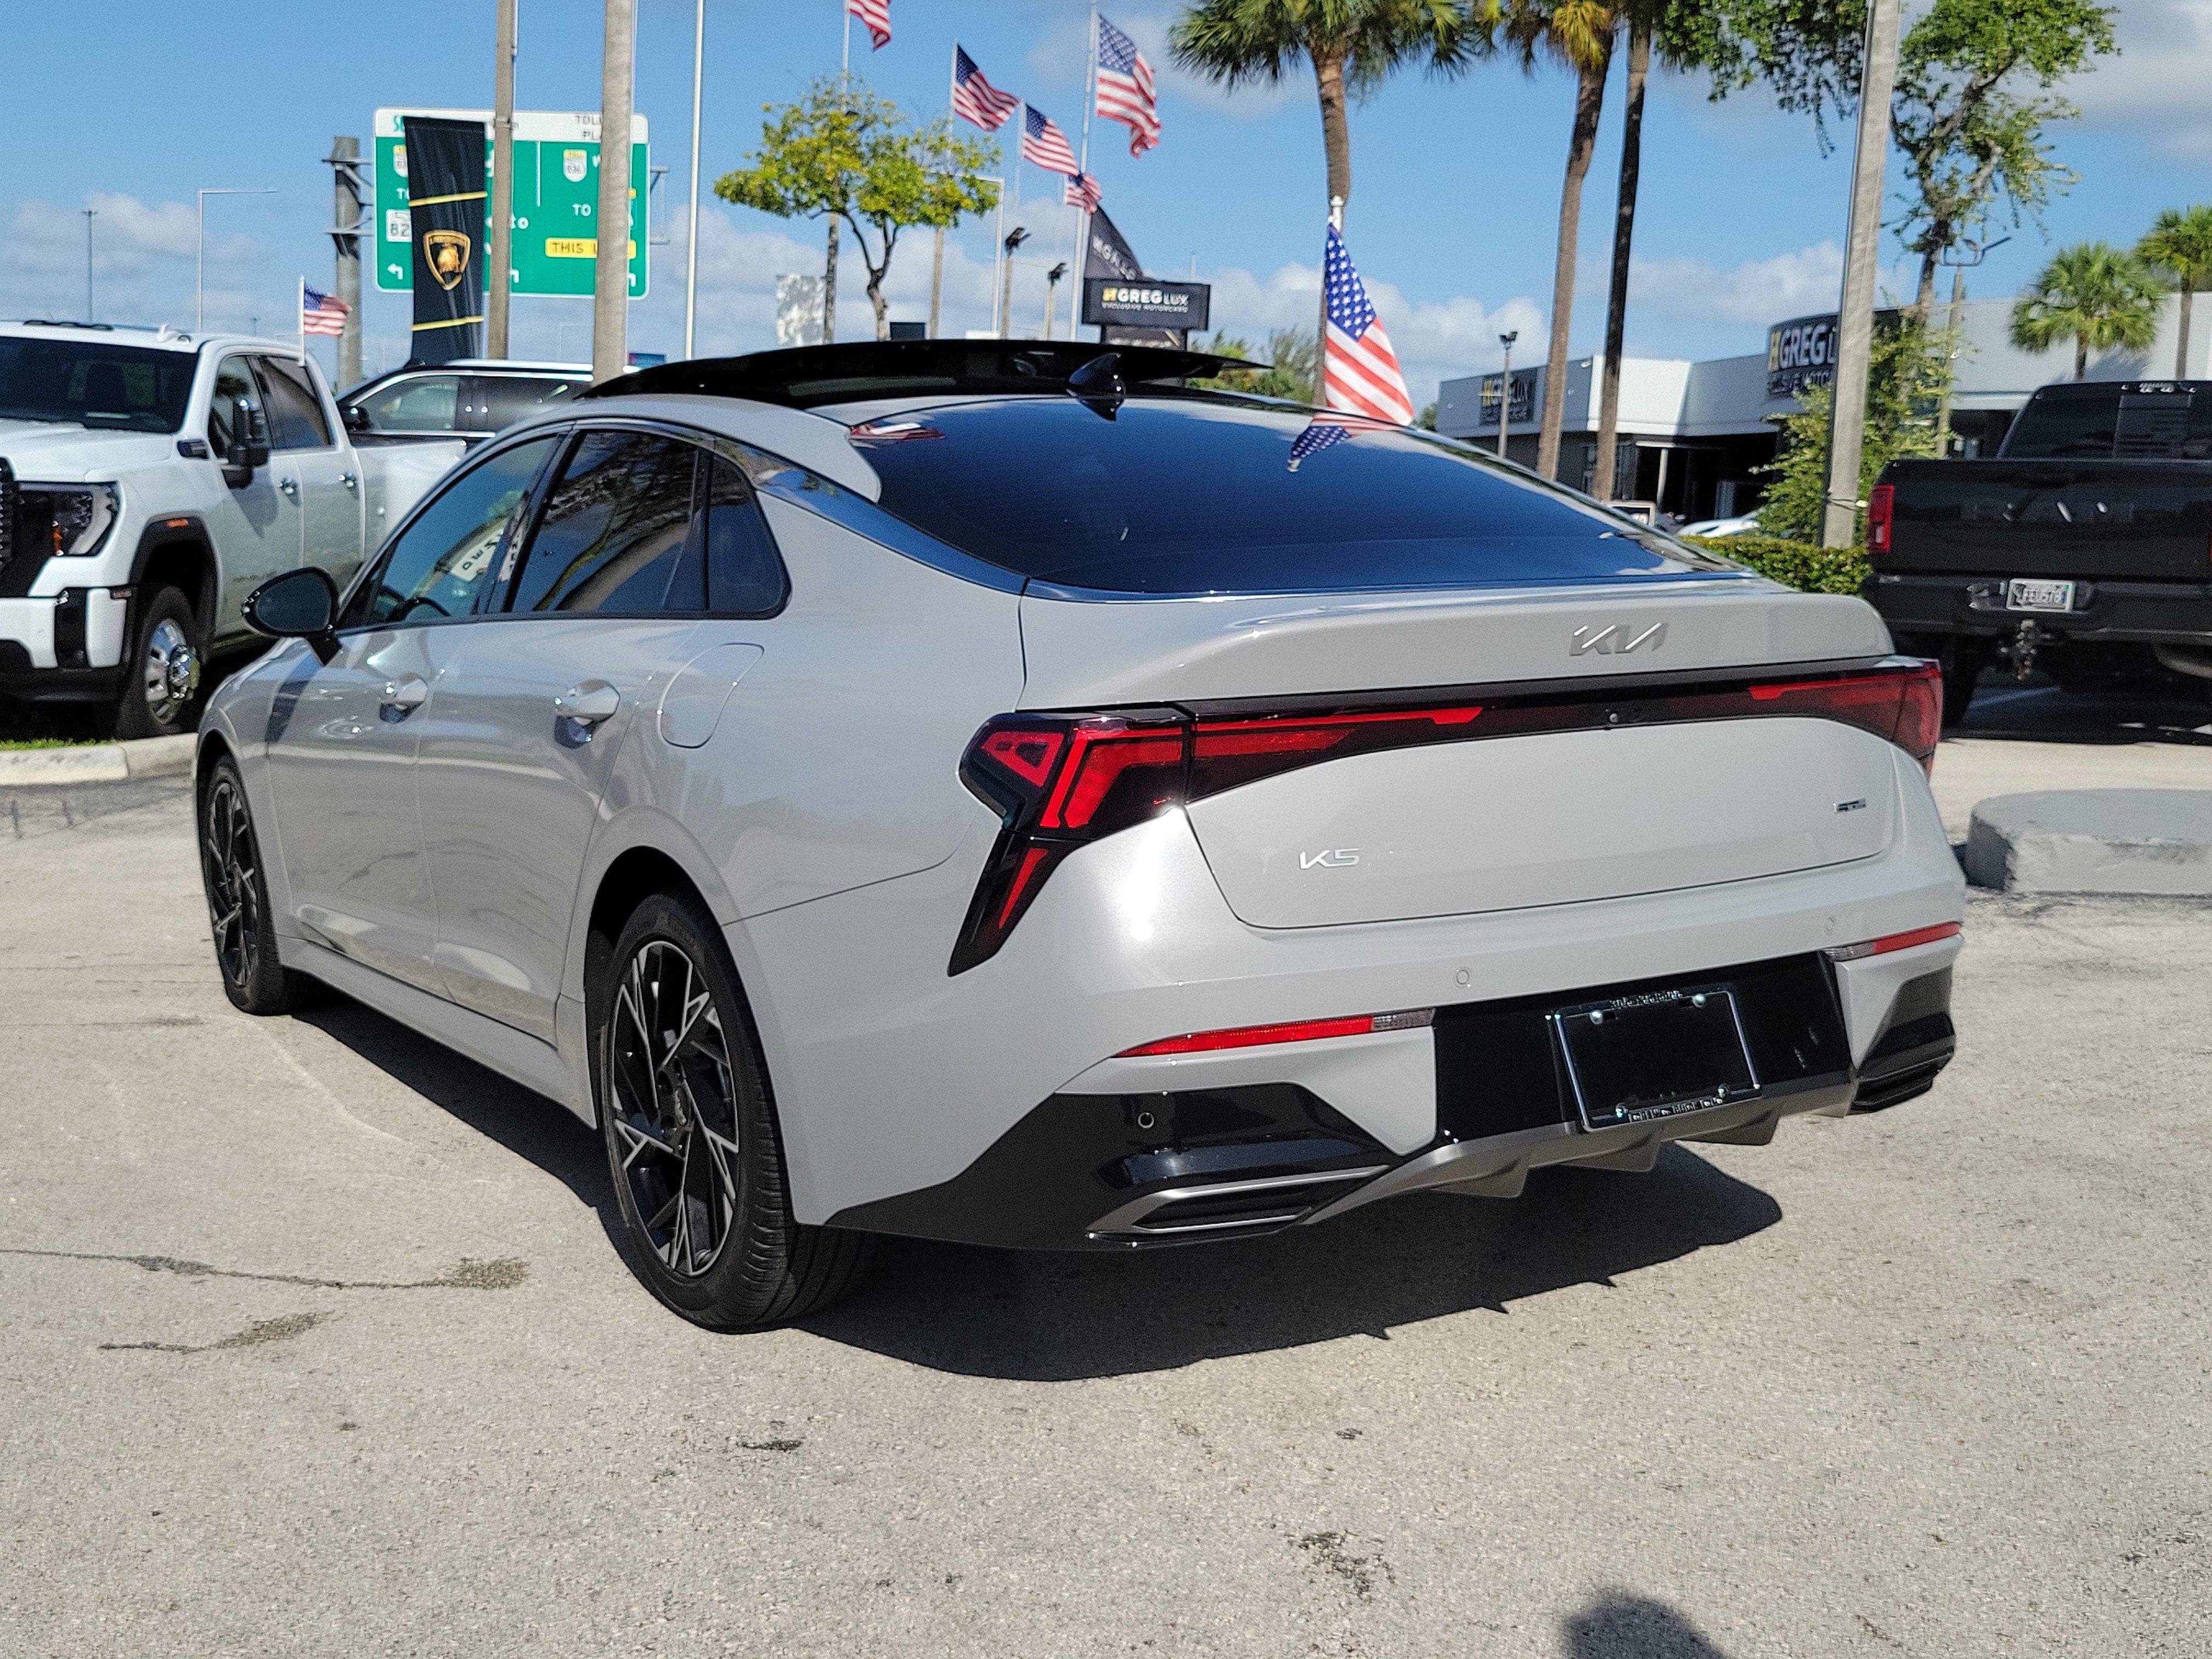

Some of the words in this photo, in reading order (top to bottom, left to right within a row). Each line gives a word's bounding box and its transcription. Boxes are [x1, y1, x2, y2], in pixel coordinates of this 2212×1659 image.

[572, 204, 591, 216] TO
[552, 242, 584, 254] THIS
[1568, 622, 1669, 657] KIA
[1299, 848, 1360, 870] K5
